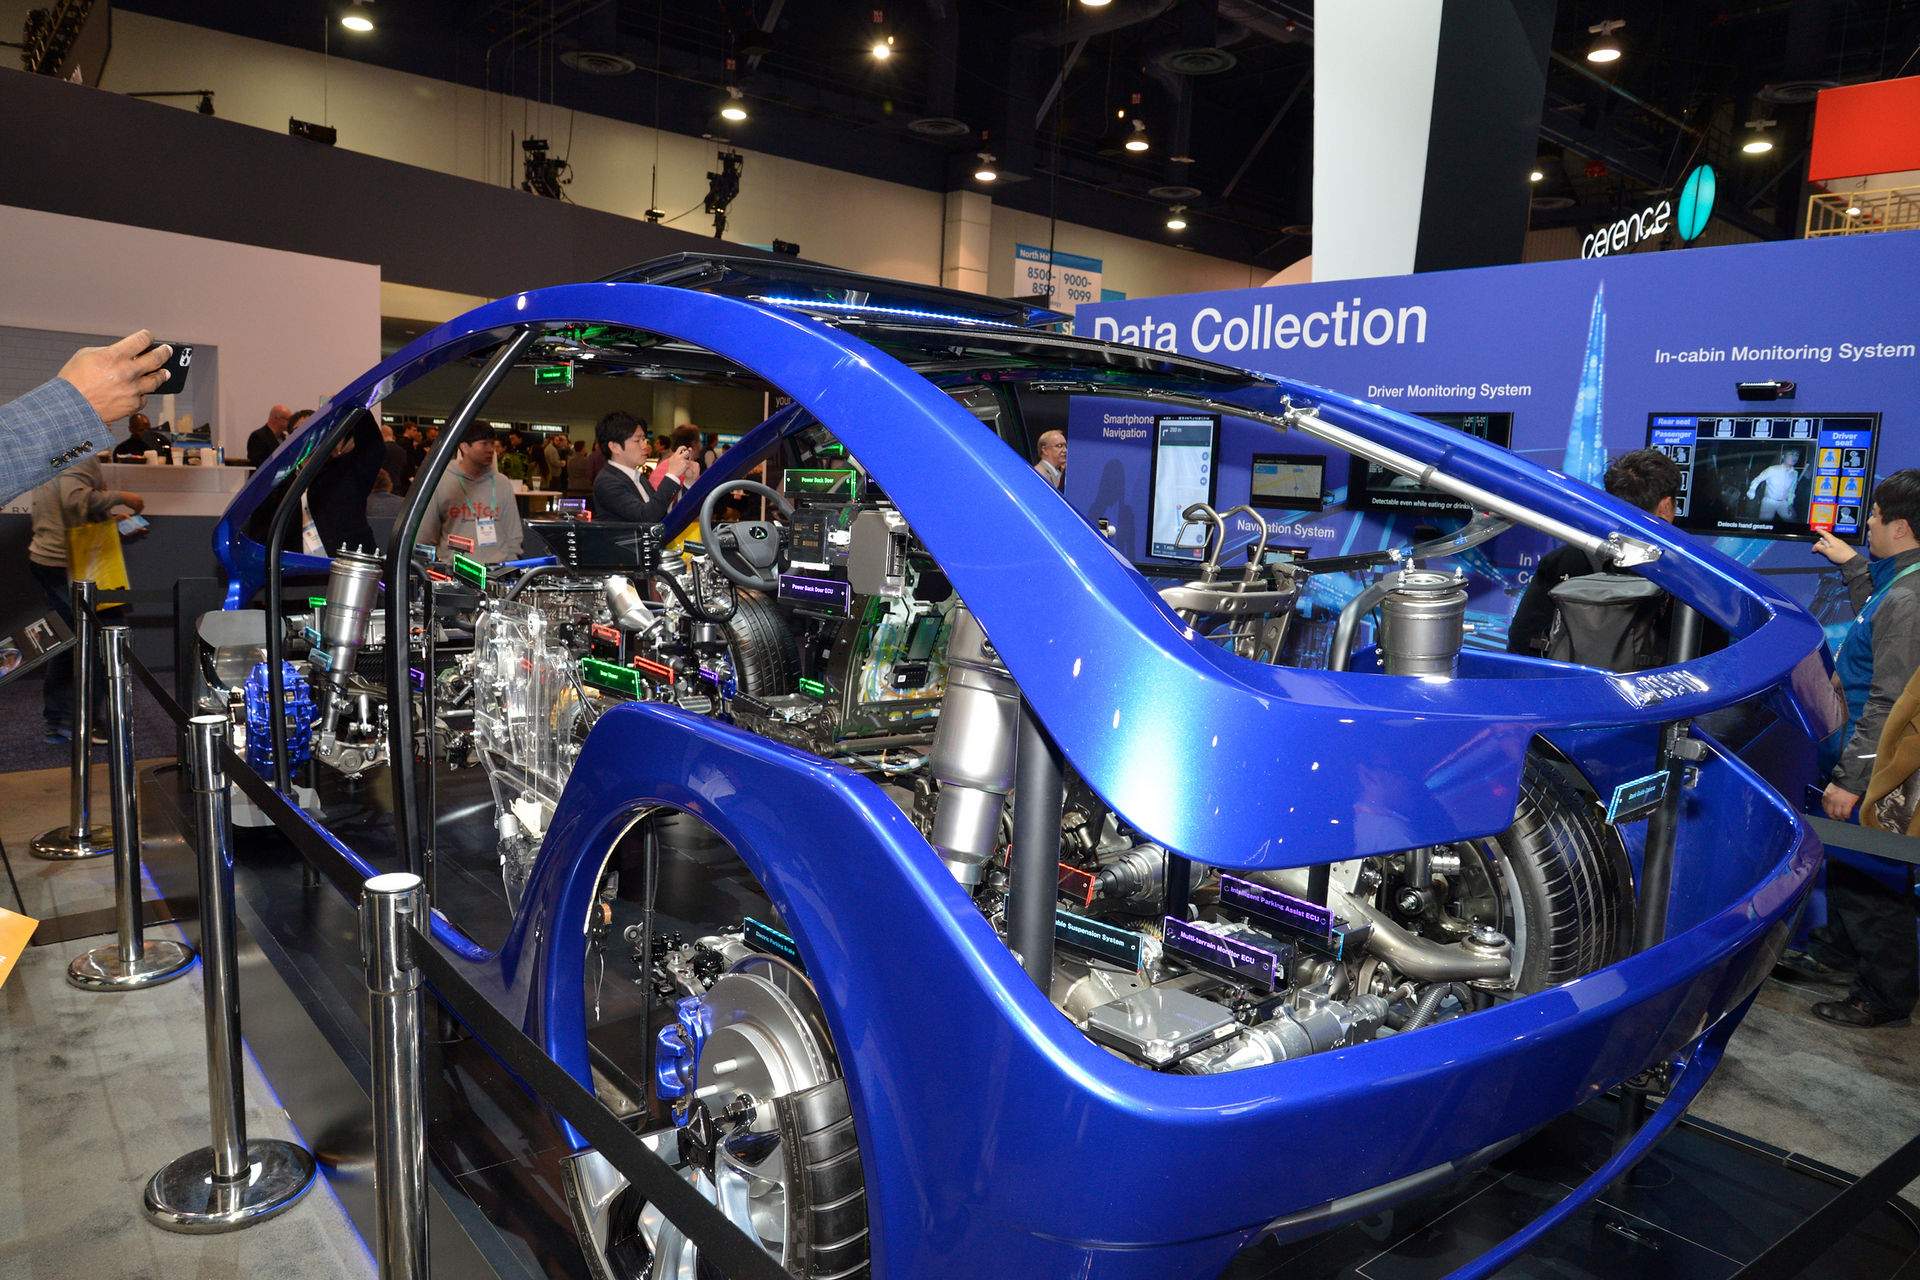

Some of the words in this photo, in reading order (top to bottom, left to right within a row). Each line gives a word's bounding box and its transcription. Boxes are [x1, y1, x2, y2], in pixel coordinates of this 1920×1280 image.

[1582, 200, 1671, 260] cerence
[1020, 249, 1039, 258] North
[1027, 267, 1056, 280] 8500-
[1064, 273, 1092, 287] 9000-
[1032, 283, 1055, 296] 8599
[1068, 289, 1091, 302] 9099
[1191, 297, 1427, 353] Collection
[1655, 348, 1725, 364] In-cabin
[1731, 344, 1833, 363] Monitoring
[1838, 342, 1916, 362] System
[1367, 384, 1404, 398] Driver
[1406, 384, 1477, 400] Monitoring
[1479, 383, 1532, 399] System
[1103, 413, 1155, 426] Smartphone
[1102, 427, 1147, 440] Navigation
[1654, 430, 1692, 439] Passenger
[1831, 432, 1858, 440] Driver
[1371, 497, 1399, 506] Detectable
[1294, 523, 1335, 538] System
[1520, 553, 1532, 567] In
[792, 583, 804, 591] Power
[1230, 886, 1260, 902] Intelligent
[1260, 896, 1285, 911] Parking
[1285, 905, 1305, 918] Assist
[1305, 912, 1320, 923] ECU
[1067, 922, 1101, 940] Suspension
[1102, 933, 1125, 947] System
[1180, 930, 1216, 951] Multi-terrain
[1216, 944, 1241, 959] Monitor
[1241, 953, 1255, 965] ECU
